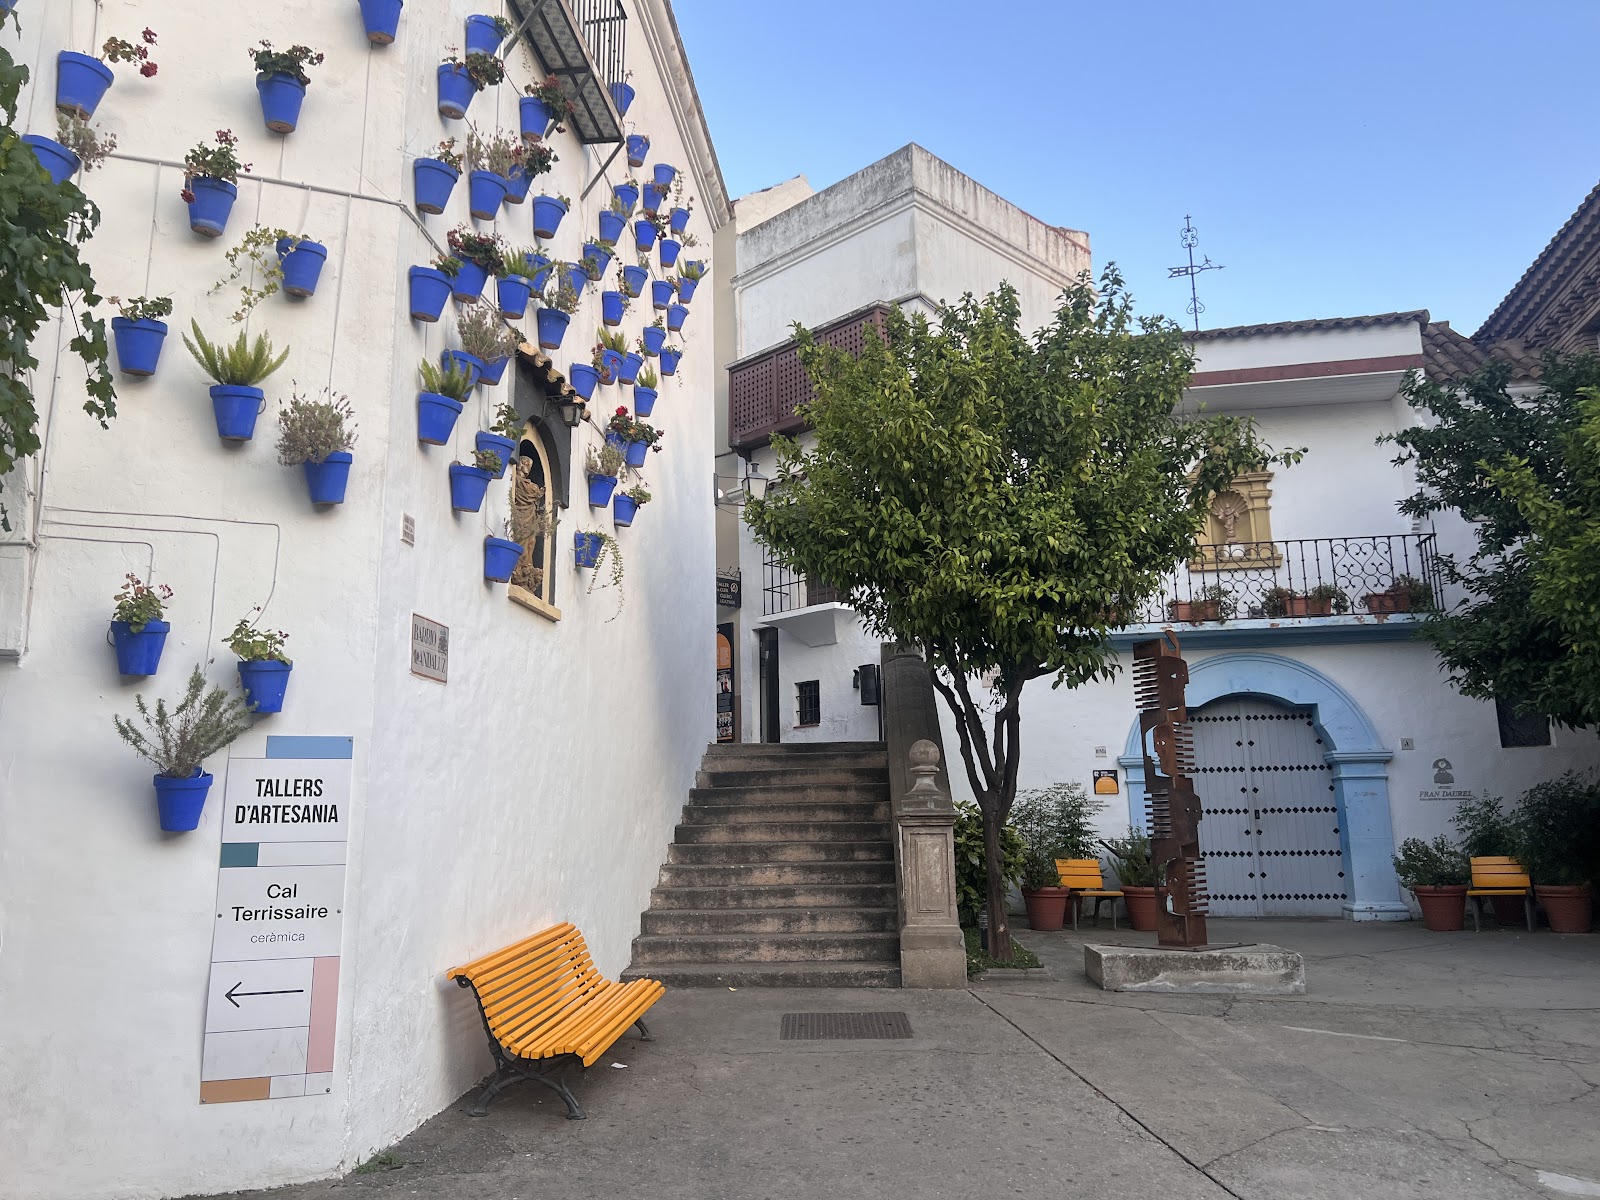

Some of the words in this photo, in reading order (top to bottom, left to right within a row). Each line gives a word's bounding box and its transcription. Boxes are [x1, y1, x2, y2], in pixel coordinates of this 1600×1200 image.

[414, 623, 437, 646] BARRIO
[255, 778, 324, 798] TALLERS
[1419, 790, 1441, 798] FRAN
[234, 804, 339, 824] D'ARTESANIA
[266, 883, 298, 899] Cal
[231, 903, 329, 922] Terrissaire
[250, 931, 306, 944] ceràmica
